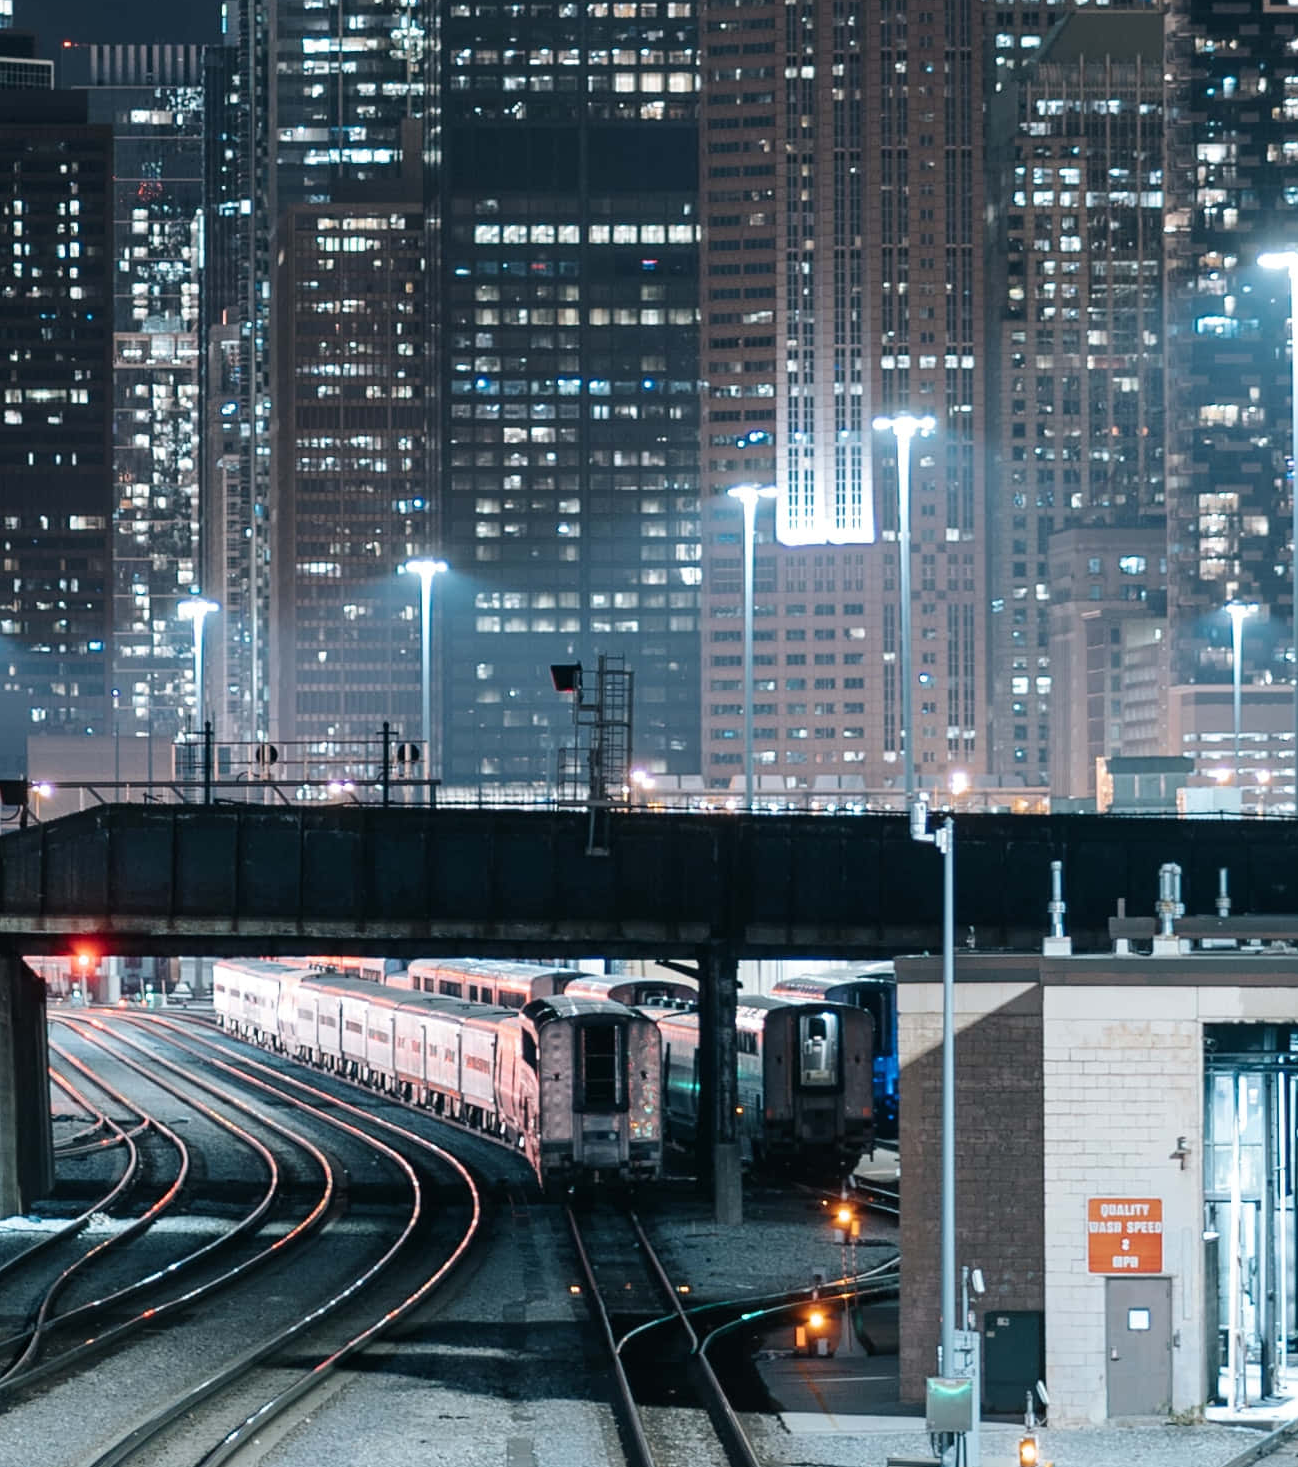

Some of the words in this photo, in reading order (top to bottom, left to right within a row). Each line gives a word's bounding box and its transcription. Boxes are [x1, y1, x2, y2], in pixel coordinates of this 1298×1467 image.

[1100, 1203, 1150, 1218] QUALITY
[1089, 1221, 1122, 1234] WASH
[1126, 1221, 1162, 1234] SPEED
